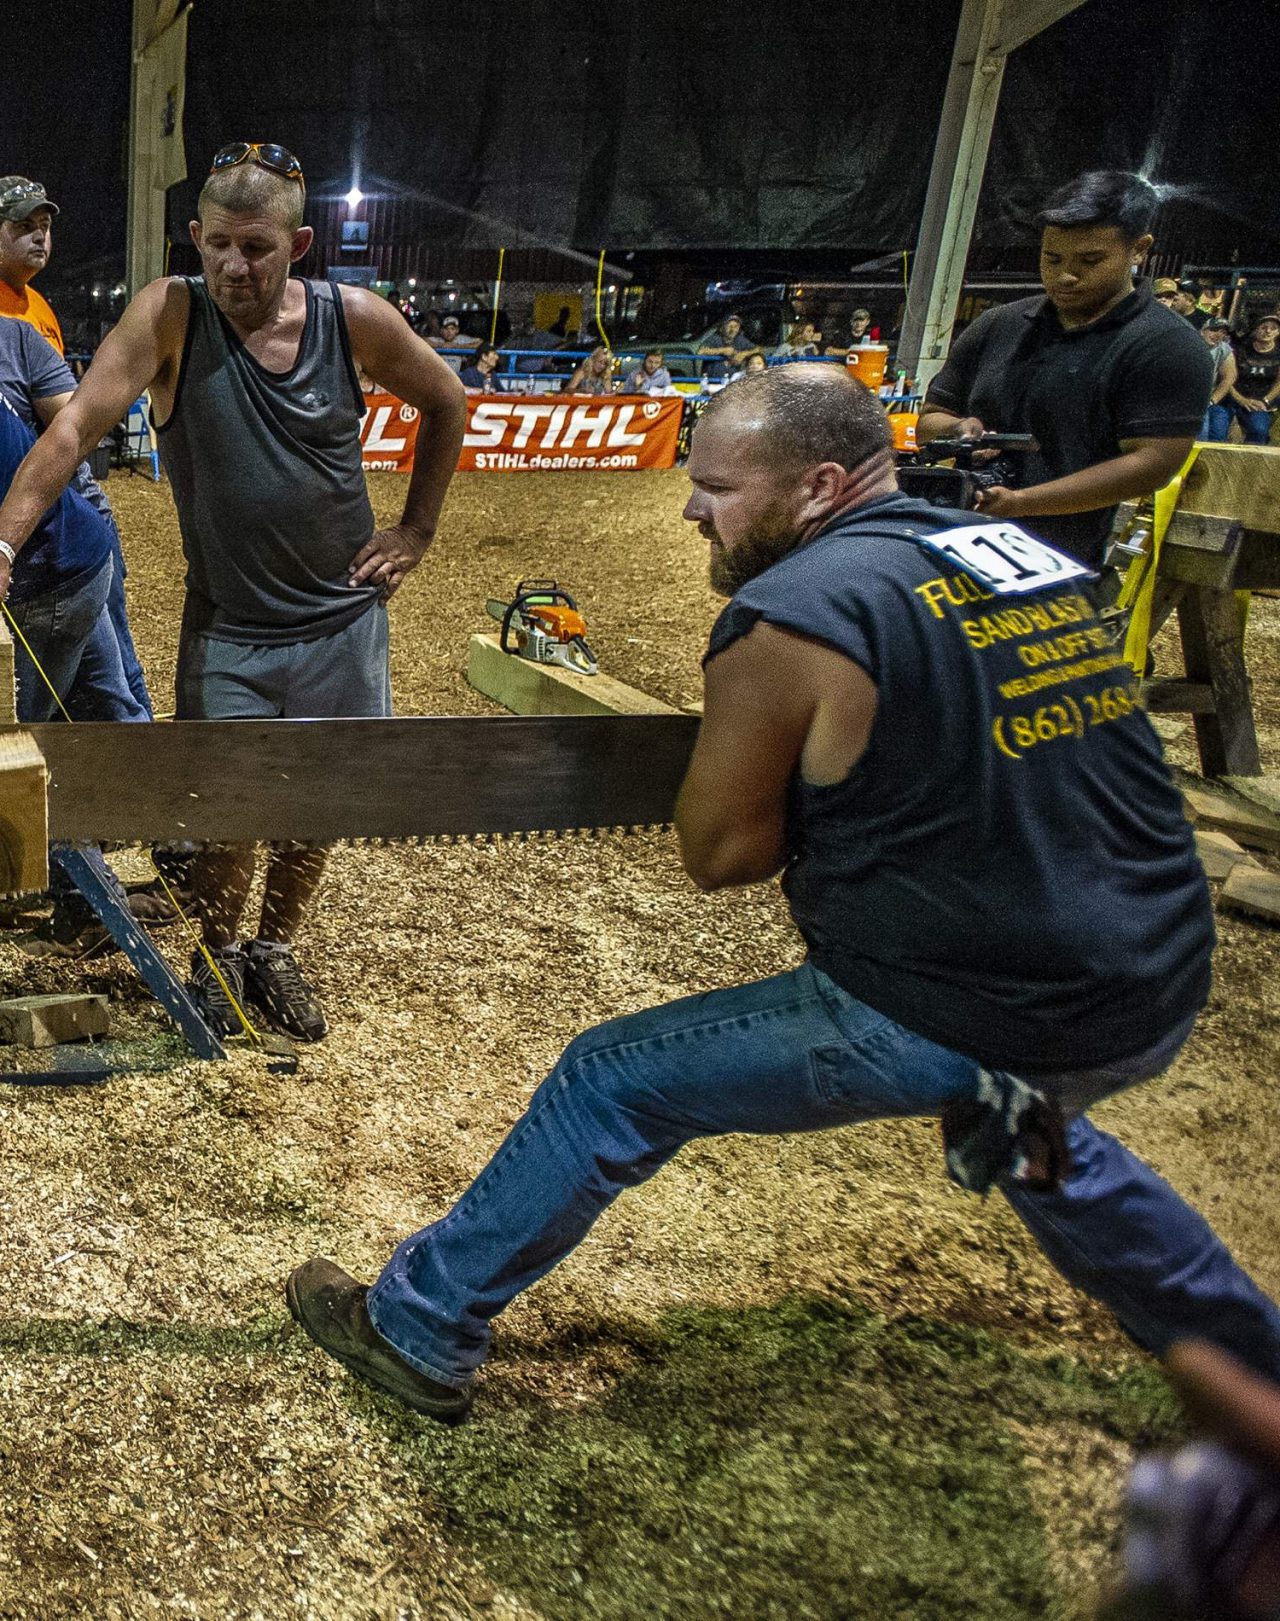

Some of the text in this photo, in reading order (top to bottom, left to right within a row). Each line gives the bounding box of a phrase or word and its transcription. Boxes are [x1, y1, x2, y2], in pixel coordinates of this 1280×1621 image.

[463, 402, 647, 449] STIHL
[475, 453, 638, 469] STIHLdealers.com
[992, 694, 1085, 759] (862)
